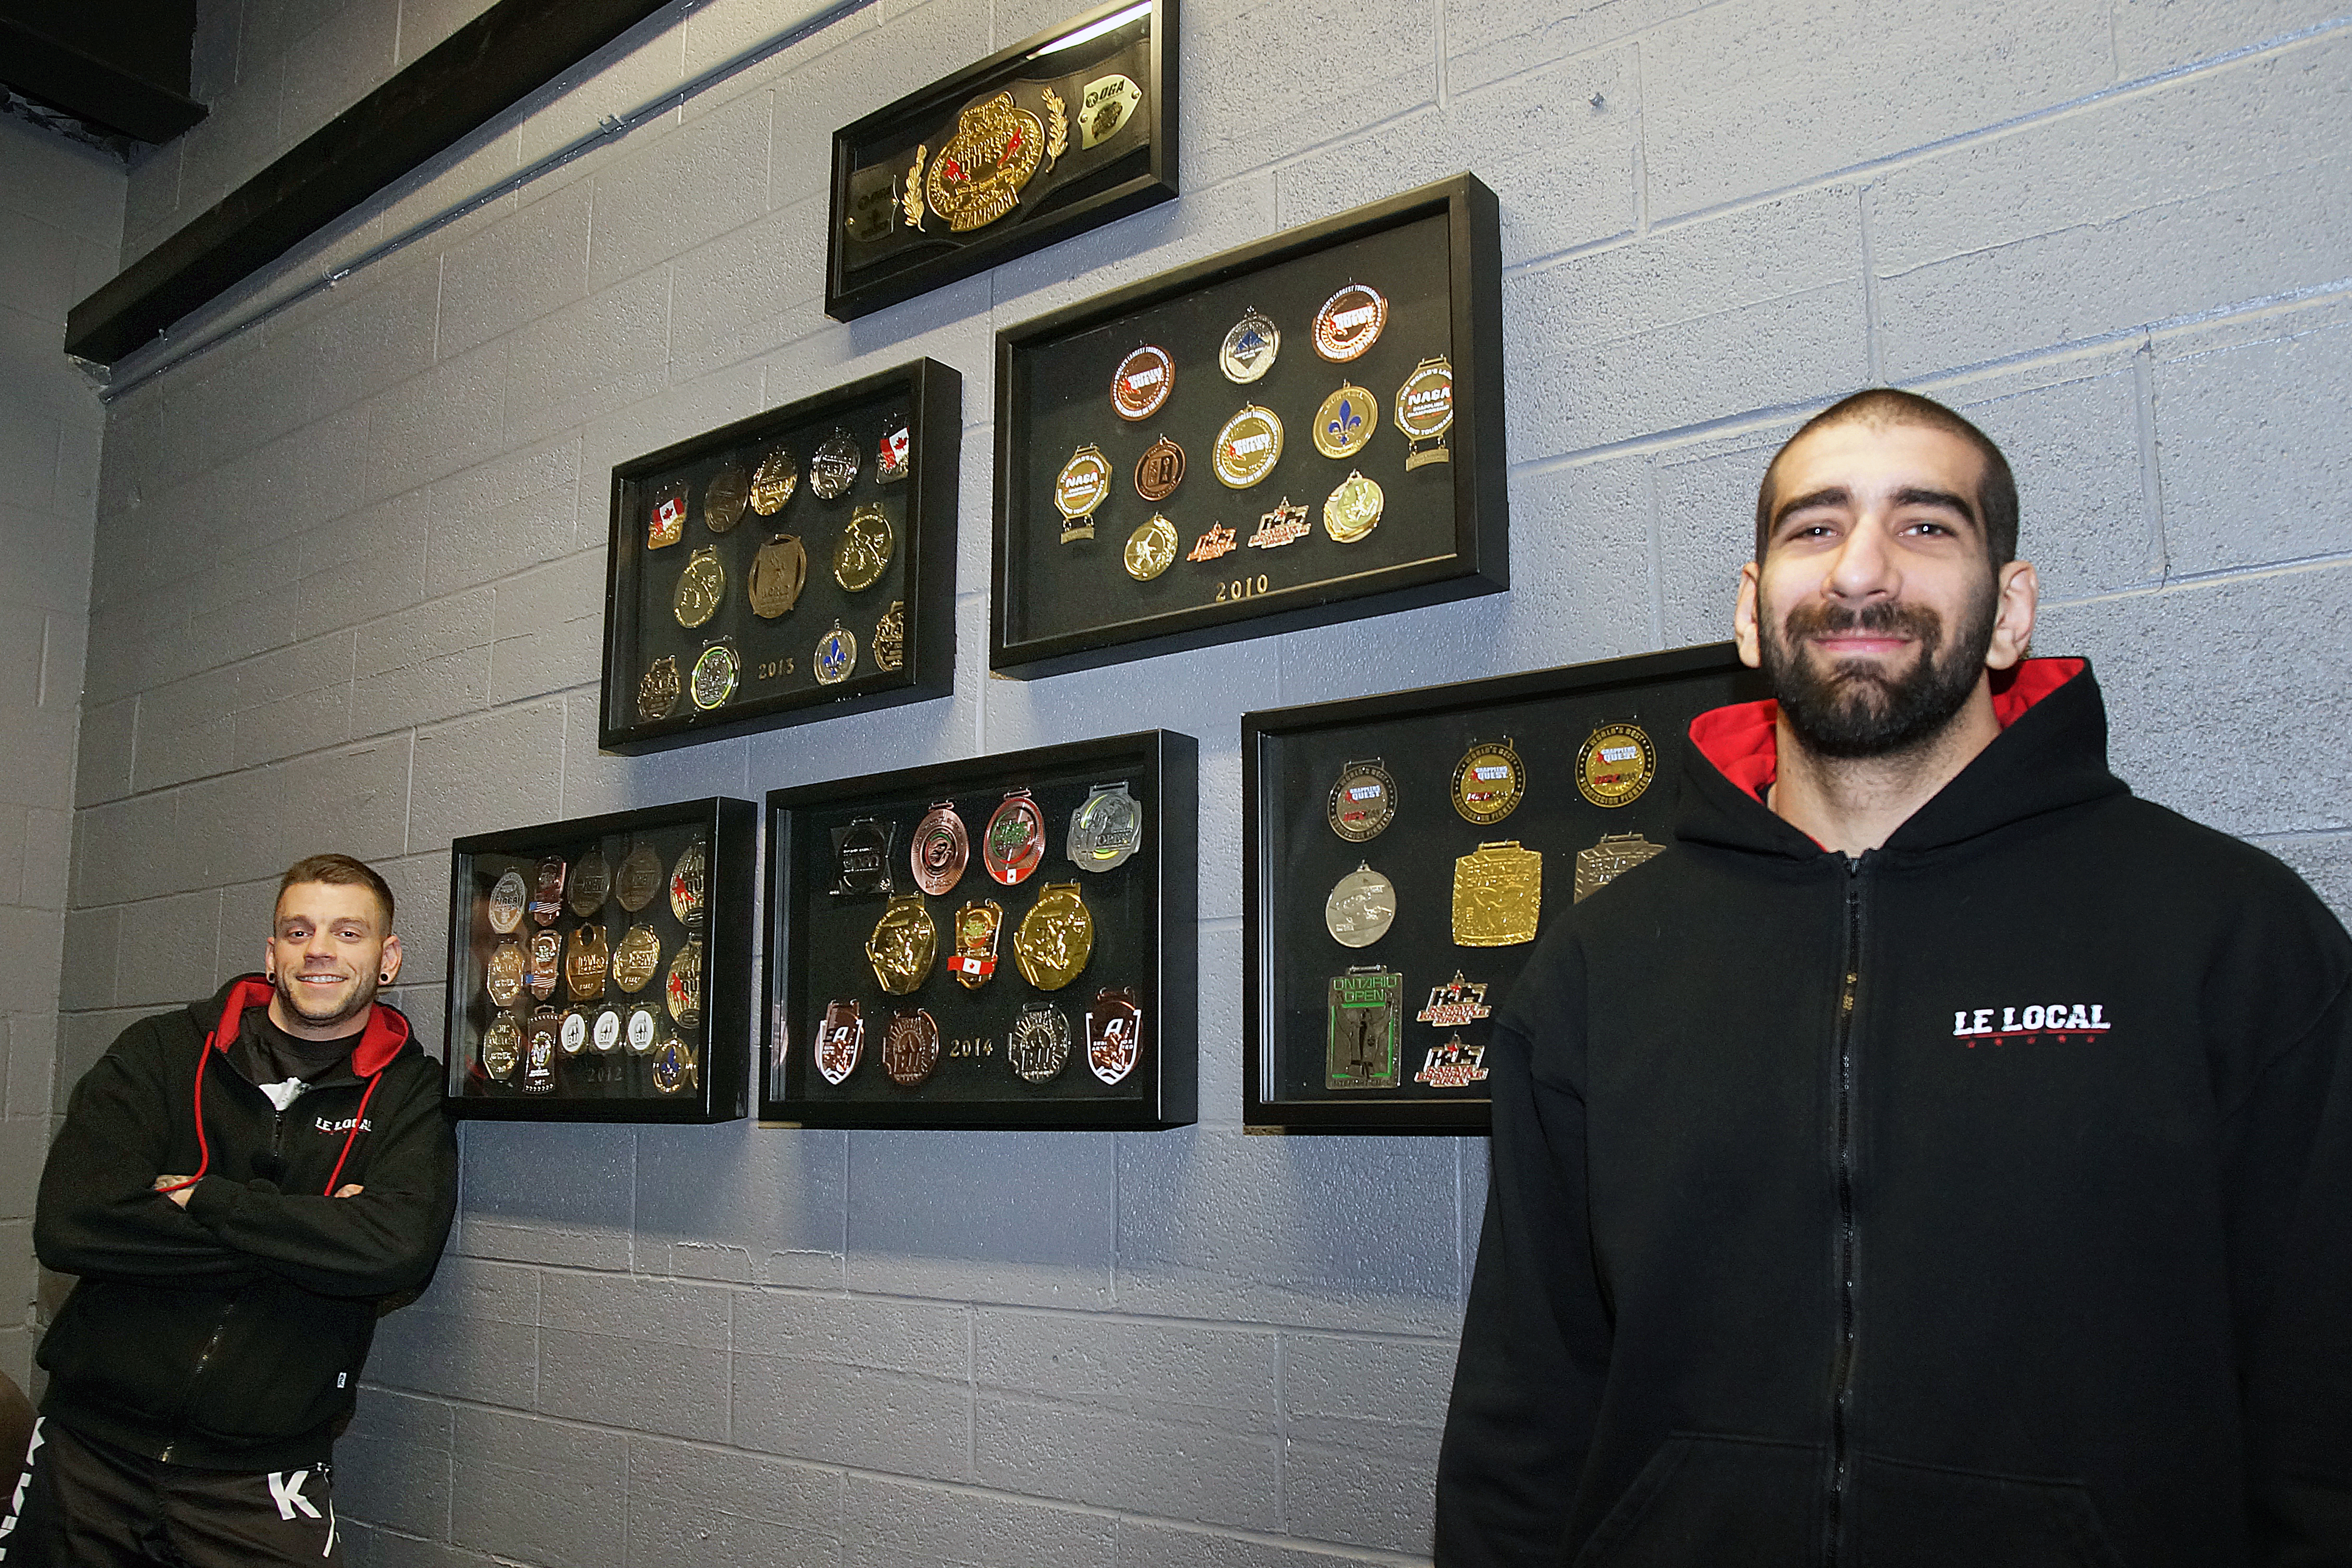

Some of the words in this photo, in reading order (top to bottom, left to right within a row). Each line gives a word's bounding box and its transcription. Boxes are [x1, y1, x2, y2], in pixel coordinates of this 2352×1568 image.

[1400, 386, 1410, 401] THE
[1409, 368, 1438, 386] WORLD'S
[1408, 386, 1451, 406] NAGA
[1066, 471, 1098, 488] NAGA
[1216, 574, 1269, 602] 2010
[758, 658, 794, 680] 2013
[1603, 753, 1637, 762] QUEST
[1477, 772, 1507, 781] QUEST
[1352, 792, 1380, 800] QUEST
[1333, 974, 1398, 990] ONTARIO
[1345, 988, 1385, 1002] OPEN
[1953, 1008, 1994, 1036] LE
[2001, 1004, 2111, 1032] LOCAL
[949, 1038, 994, 1058] 2014
[315, 1117, 333, 1131] LE
